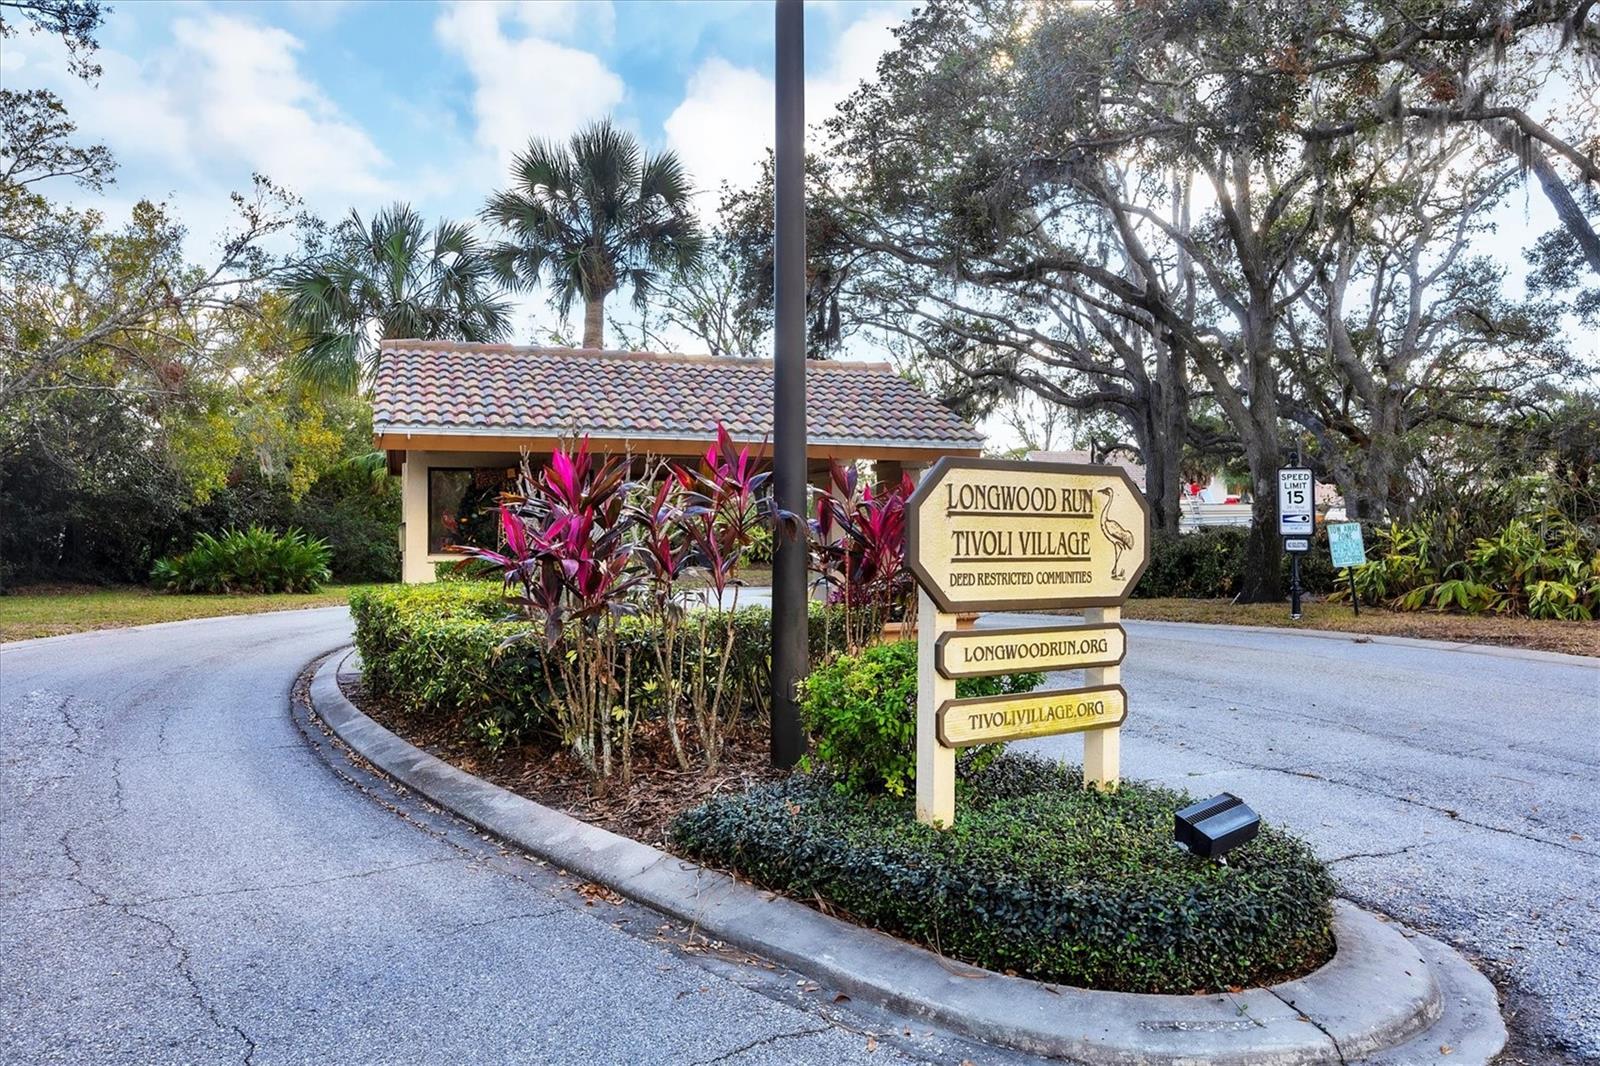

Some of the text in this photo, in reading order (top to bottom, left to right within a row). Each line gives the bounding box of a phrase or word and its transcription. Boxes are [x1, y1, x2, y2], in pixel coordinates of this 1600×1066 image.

[1281, 473, 1310, 481] SPEED
[945, 482, 1093, 513] LONGWOOD RUN
[1287, 490, 1304, 504] 15
[951, 530, 1091, 556] TIVOLI VILLAGE
[950, 571, 1092, 587] DEED RESTRICTED COMMUNITIES
[964, 638, 1108, 662] LONGWOODRUN.ORG
[968, 701, 1105, 730] TIVOLIVILLAGE.ORG
